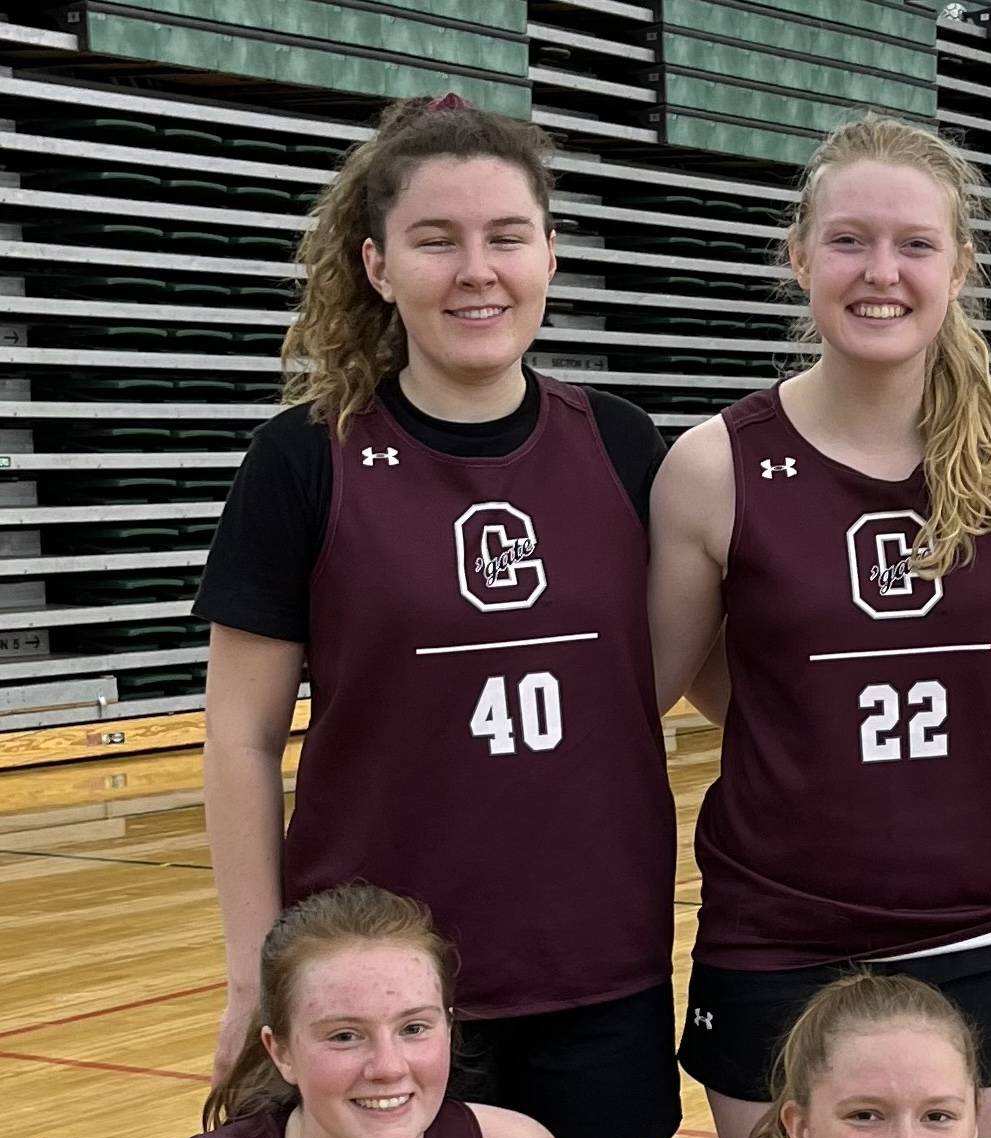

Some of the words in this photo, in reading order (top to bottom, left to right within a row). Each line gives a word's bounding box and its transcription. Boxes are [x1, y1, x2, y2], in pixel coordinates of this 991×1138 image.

[454, 502, 547, 612] C
[846, 509, 944, 620] C
[470, 672, 562, 755] 40
[859, 680, 948, 763] 22
